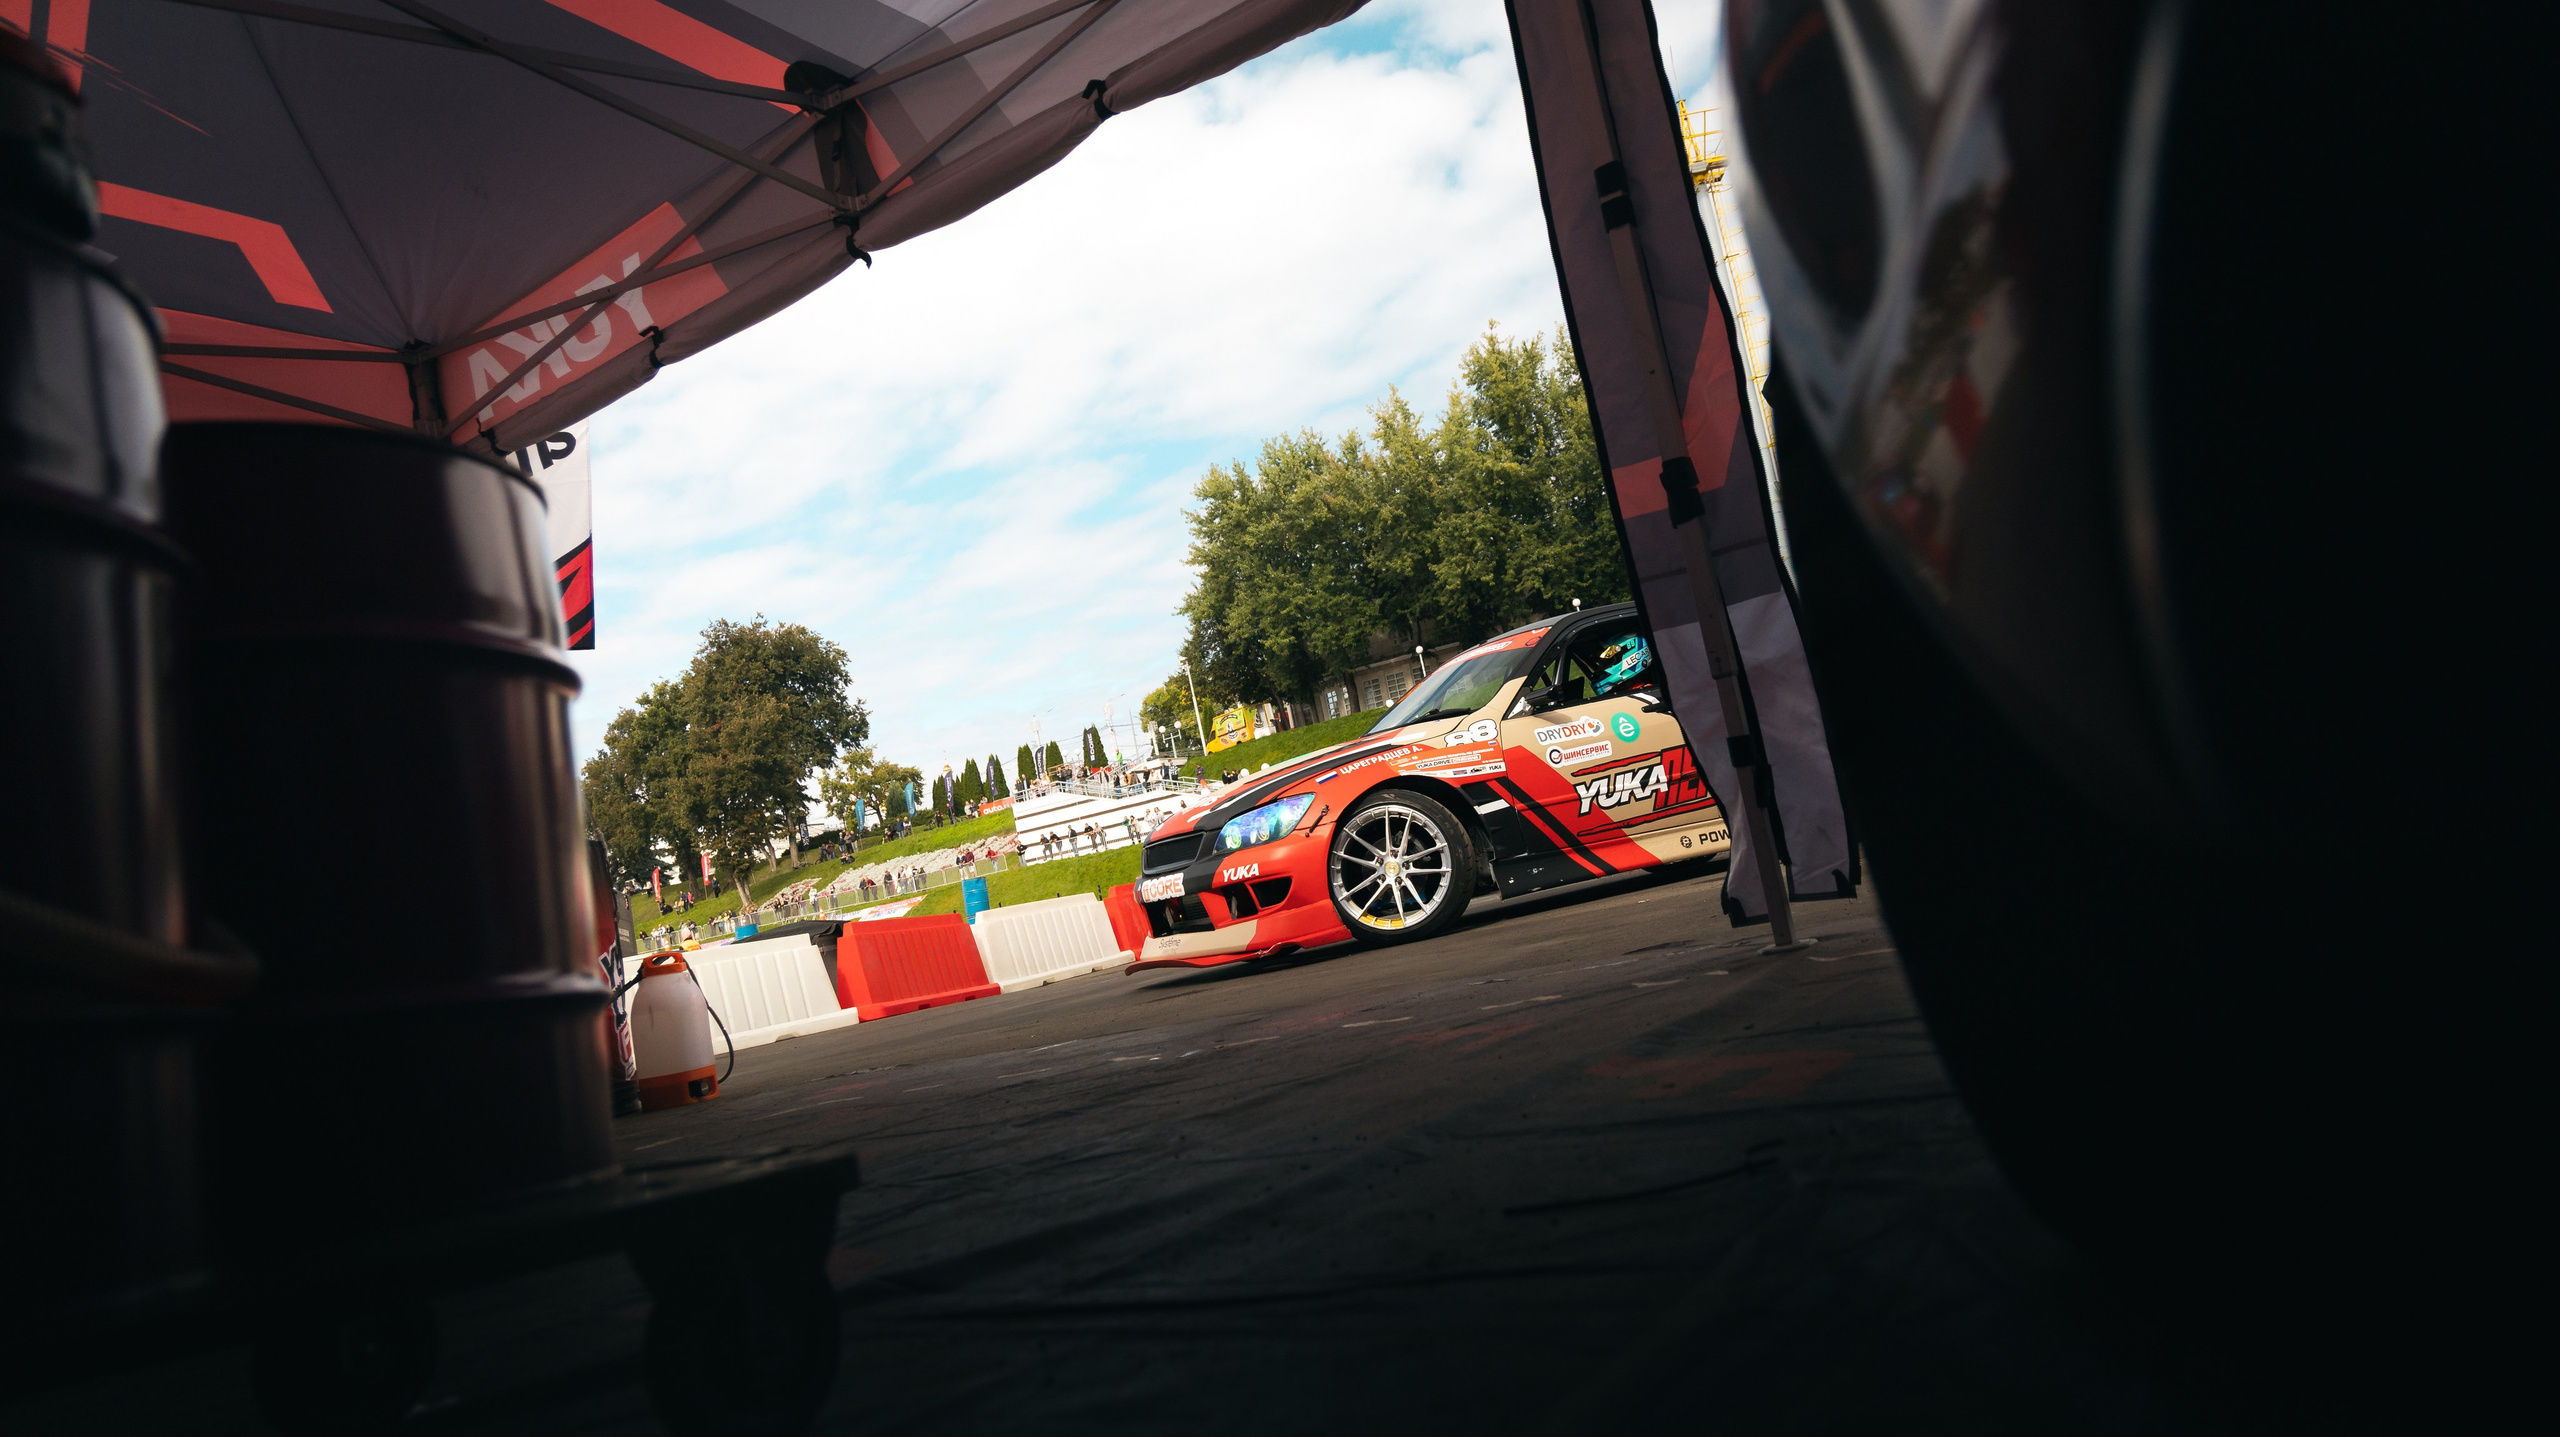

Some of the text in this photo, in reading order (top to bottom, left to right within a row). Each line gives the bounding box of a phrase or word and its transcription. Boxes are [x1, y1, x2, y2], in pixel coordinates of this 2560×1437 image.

[1537, 723, 1587, 743] DRYDRY
[1339, 747, 1412, 775] ЦАРЕГРАДЦЕВ
[1563, 743, 1610, 760] ШИНСЕРВИС
[1574, 763, 1670, 816] YUKA
[1222, 862, 1260, 883] YUKA
